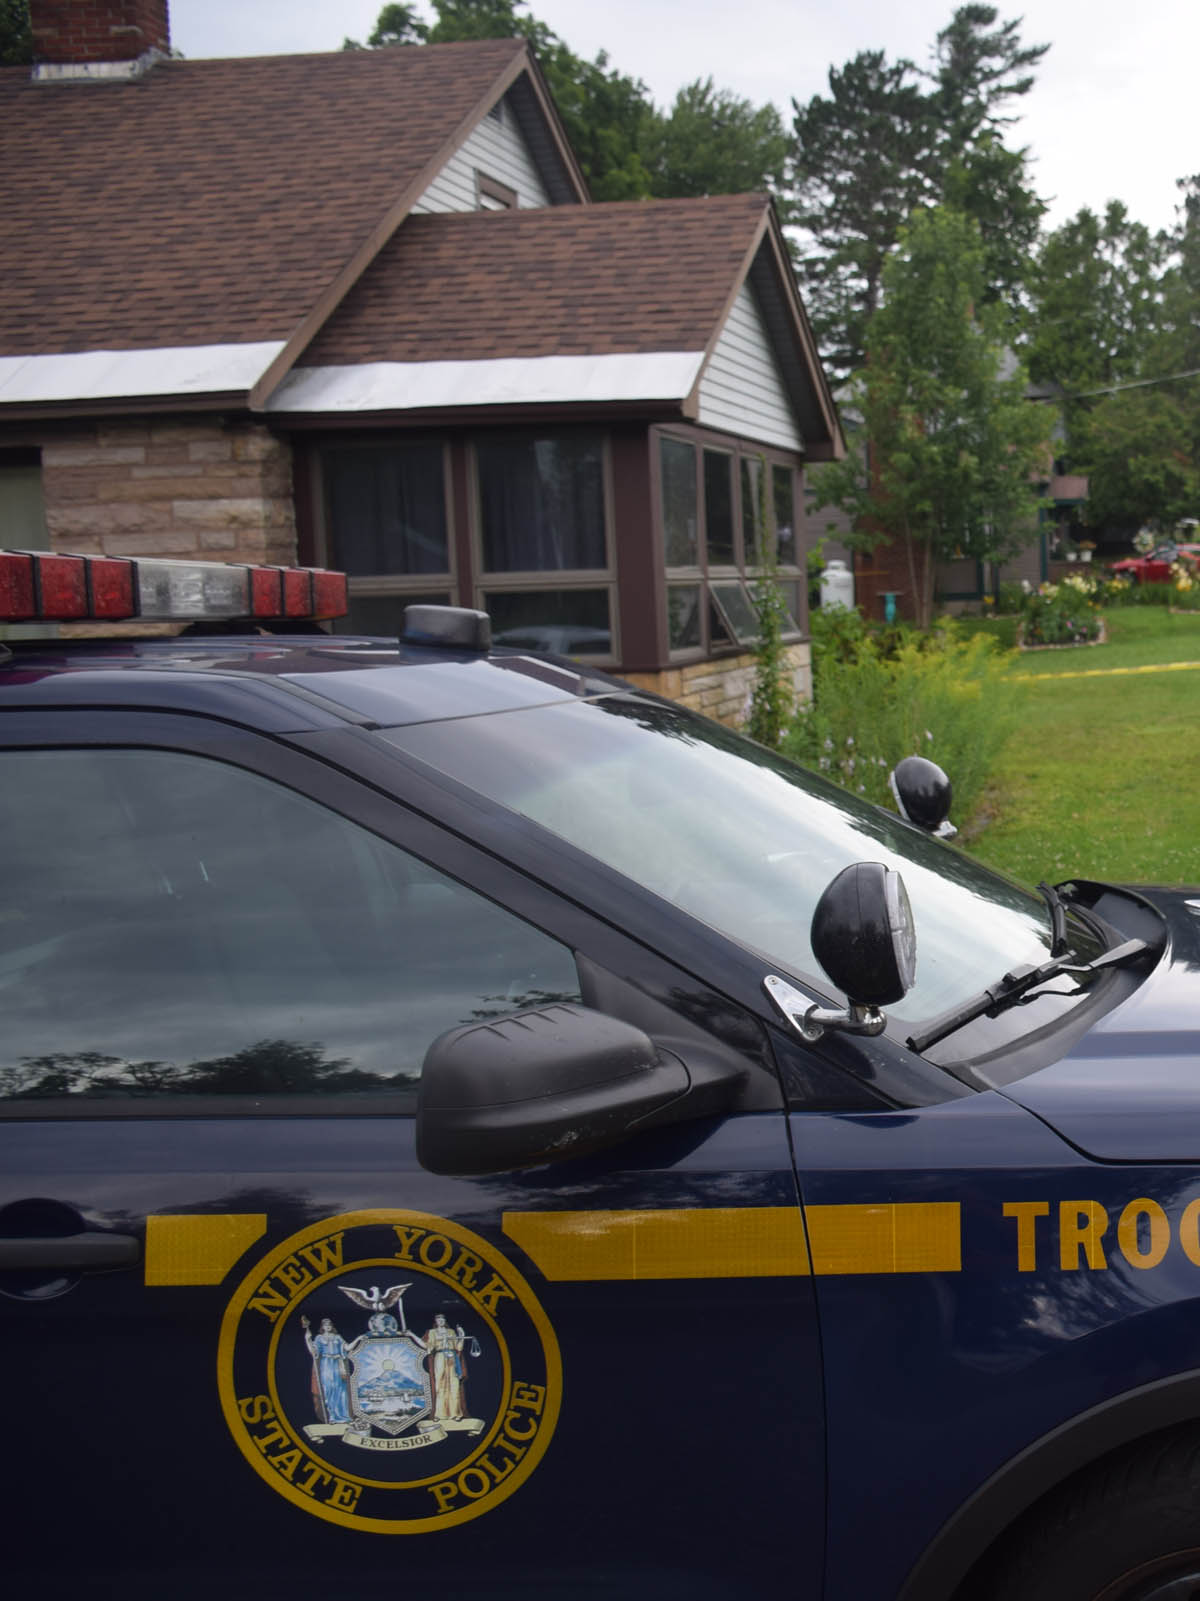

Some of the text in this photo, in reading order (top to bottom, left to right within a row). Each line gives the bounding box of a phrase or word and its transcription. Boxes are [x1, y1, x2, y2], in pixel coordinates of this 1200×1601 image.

[248, 1225, 515, 1322] NEW YORK
[238, 1381, 546, 1514] STATE POLICE
[360, 1434, 432, 1449] EXCELSIOR
